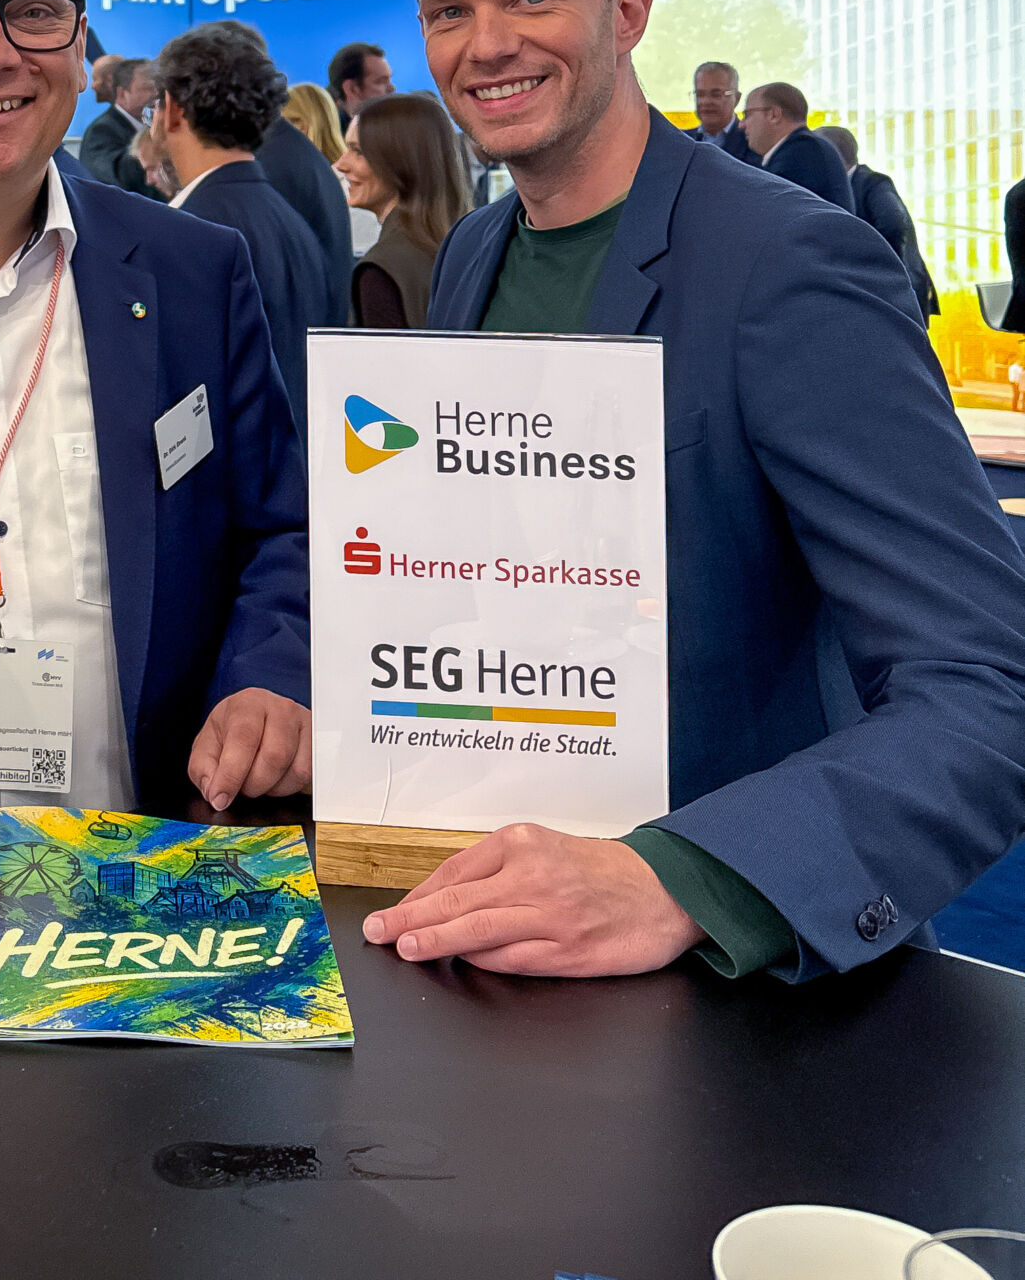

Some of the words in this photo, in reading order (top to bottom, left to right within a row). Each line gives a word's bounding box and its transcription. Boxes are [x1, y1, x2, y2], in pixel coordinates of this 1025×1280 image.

[435, 401, 553, 438] Herne
[436, 439, 636, 481] Business
[390, 553, 487, 581] Herner
[494, 558, 641, 588] Sparkasse
[371, 643, 463, 692] SEG
[478, 649, 617, 700] Herne
[371, 724, 404, 745] Wir
[407, 728, 514, 751] entwickeln
[519, 732, 551, 753] die
[555, 734, 617, 757] Stadt.
